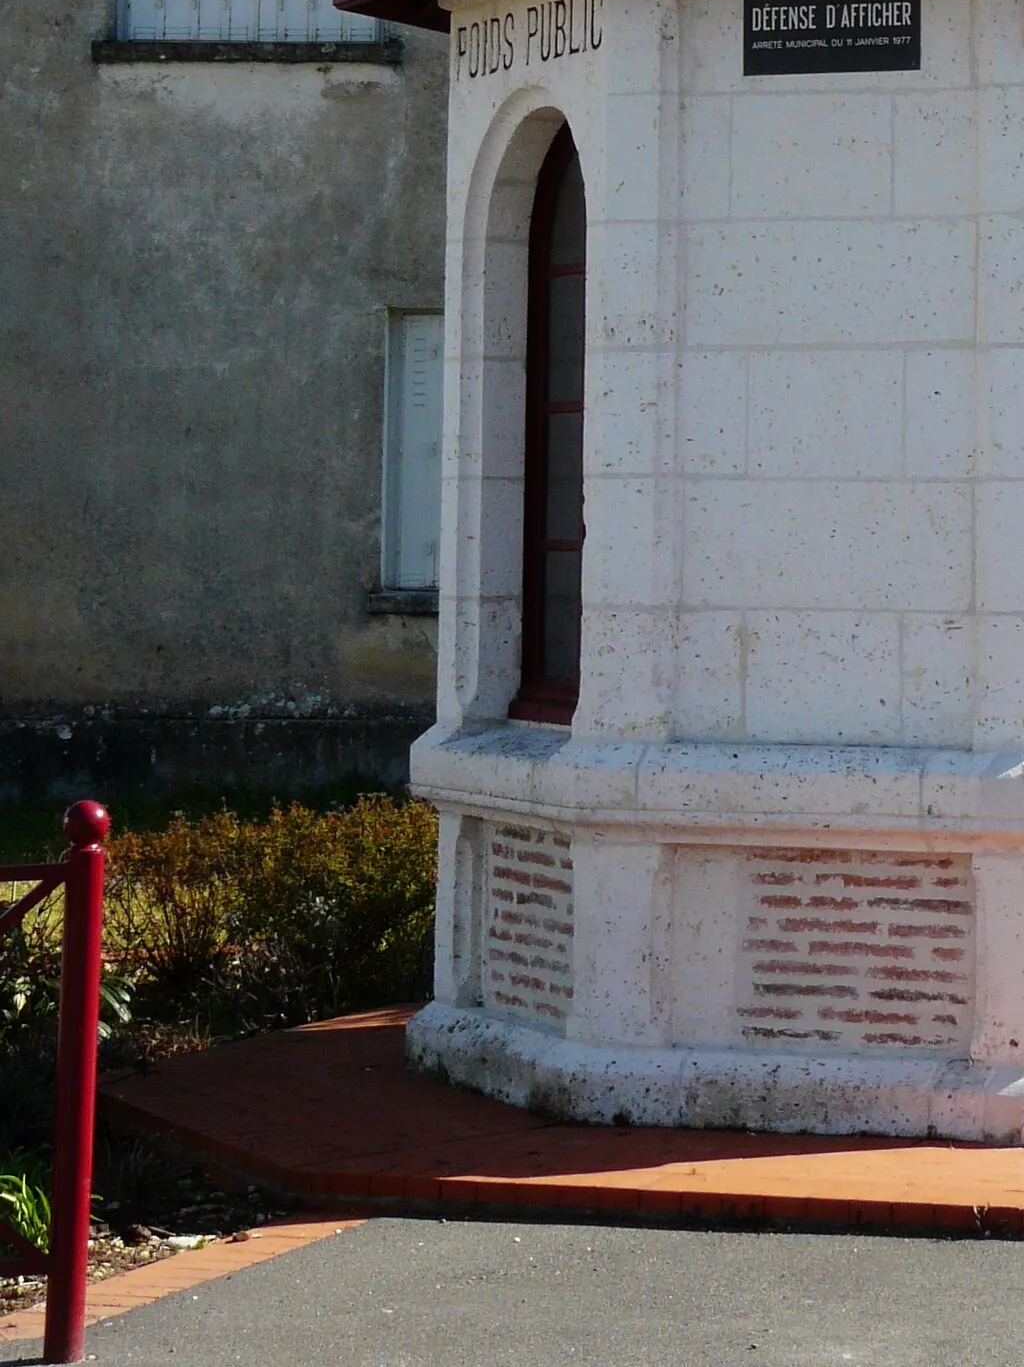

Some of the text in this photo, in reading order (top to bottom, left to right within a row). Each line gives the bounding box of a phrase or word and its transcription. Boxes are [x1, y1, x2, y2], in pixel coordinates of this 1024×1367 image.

[752, 2, 912, 32] DÉFENSE D'AFFICHER
[457, 12, 515, 81] POIDS
[786, 39, 829, 48] MUNICIPAL
[831, 38, 844, 47] DU
[855, 36, 890, 47] JANVIER
[892, 36, 912, 45] 1977
